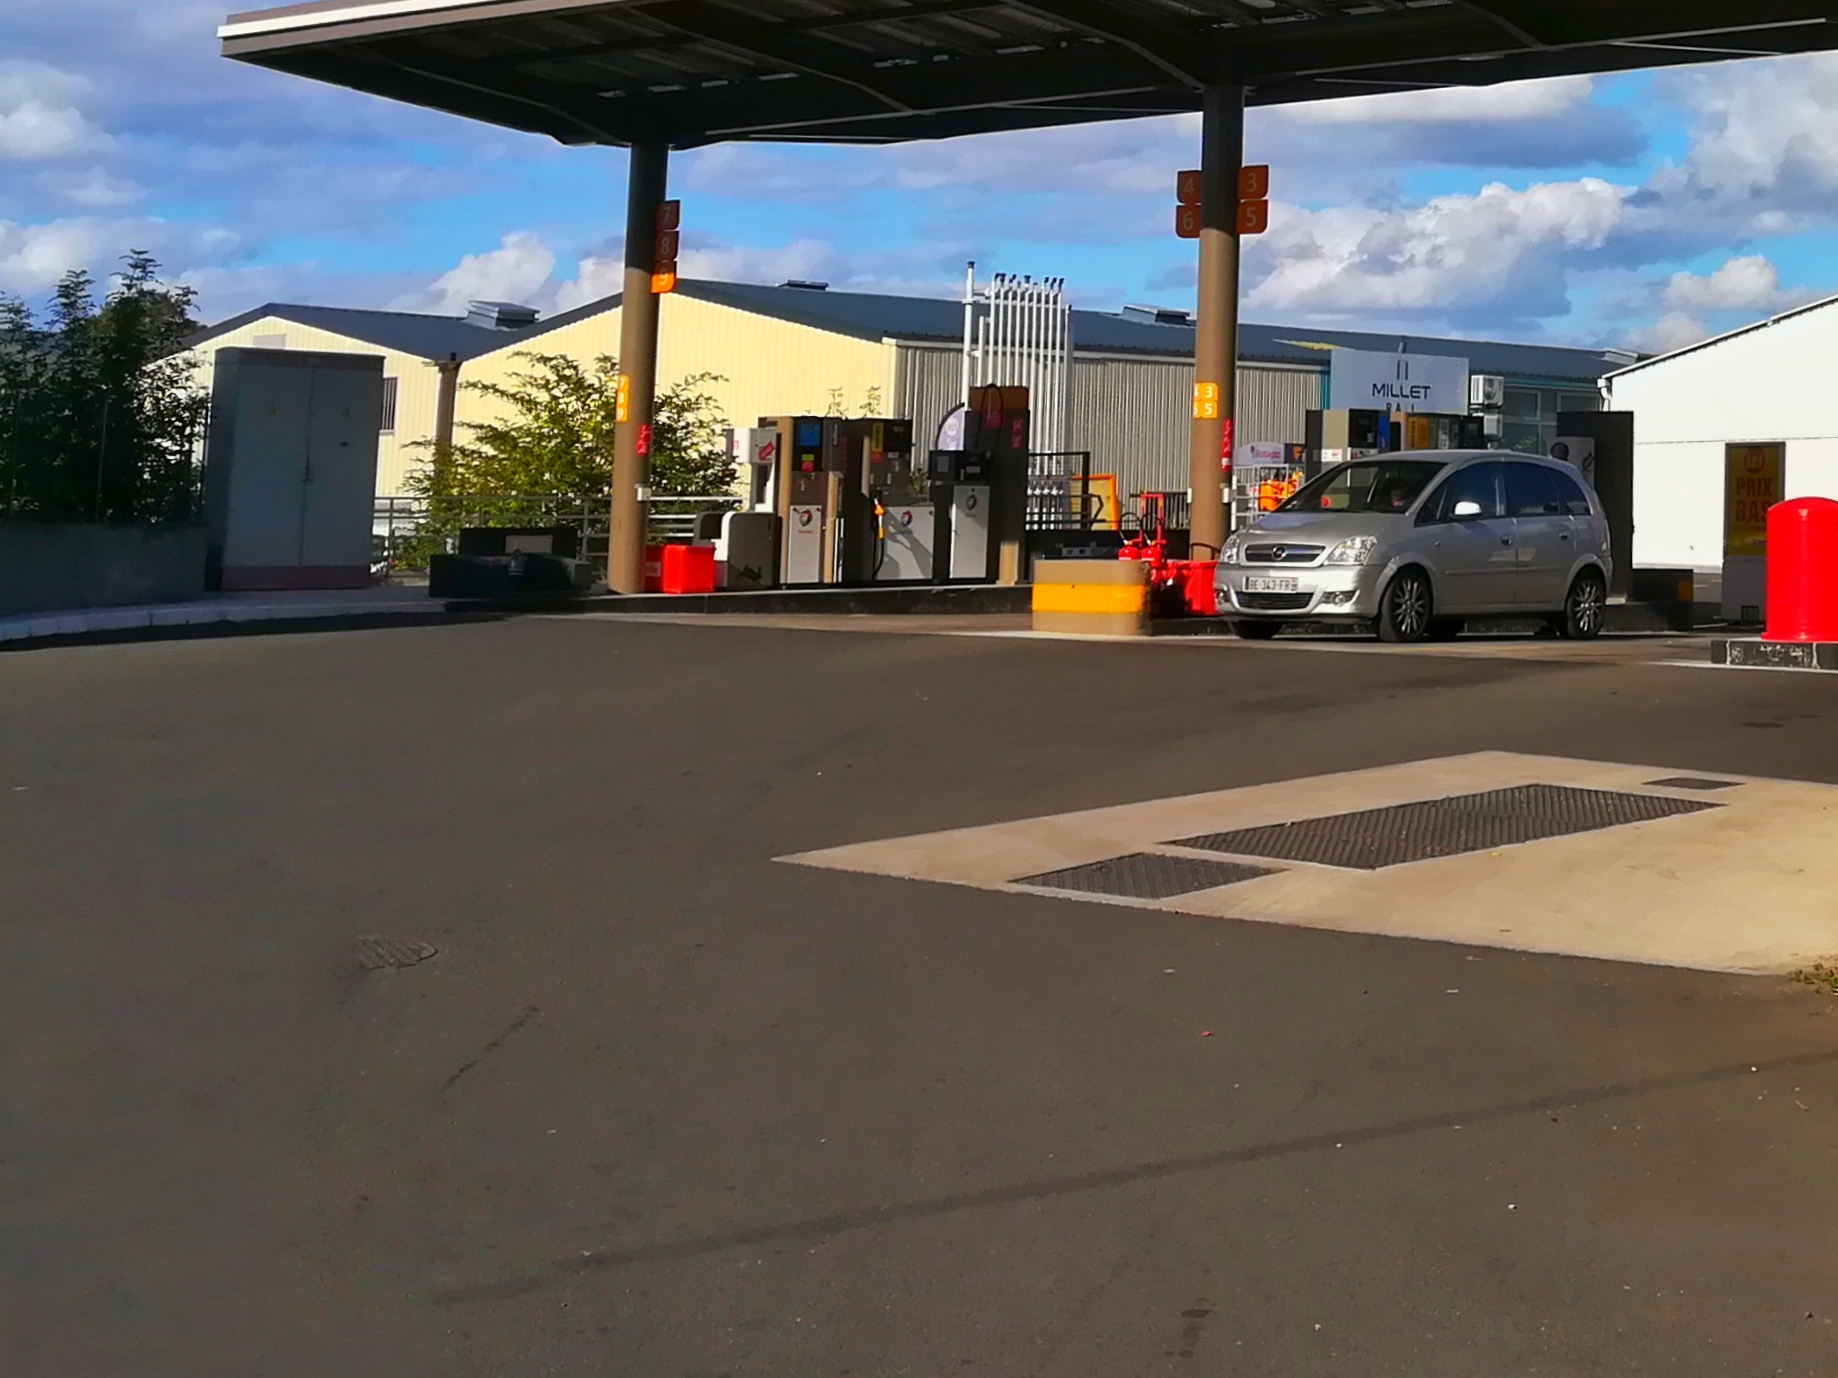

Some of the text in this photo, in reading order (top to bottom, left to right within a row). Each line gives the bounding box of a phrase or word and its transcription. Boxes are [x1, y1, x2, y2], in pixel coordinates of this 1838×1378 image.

[1184, 177, 1195, 195] 4
[1247, 172, 1257, 192] 3
[1183, 211, 1194, 230] 6
[1246, 207, 1257, 227] 5
[661, 237, 670, 255] 8
[1205, 386, 1213, 398] 3
[1372, 383, 1431, 399] MILLET
[1204, 403, 1213, 415] 5
[1736, 477, 1773, 497] PRIX
